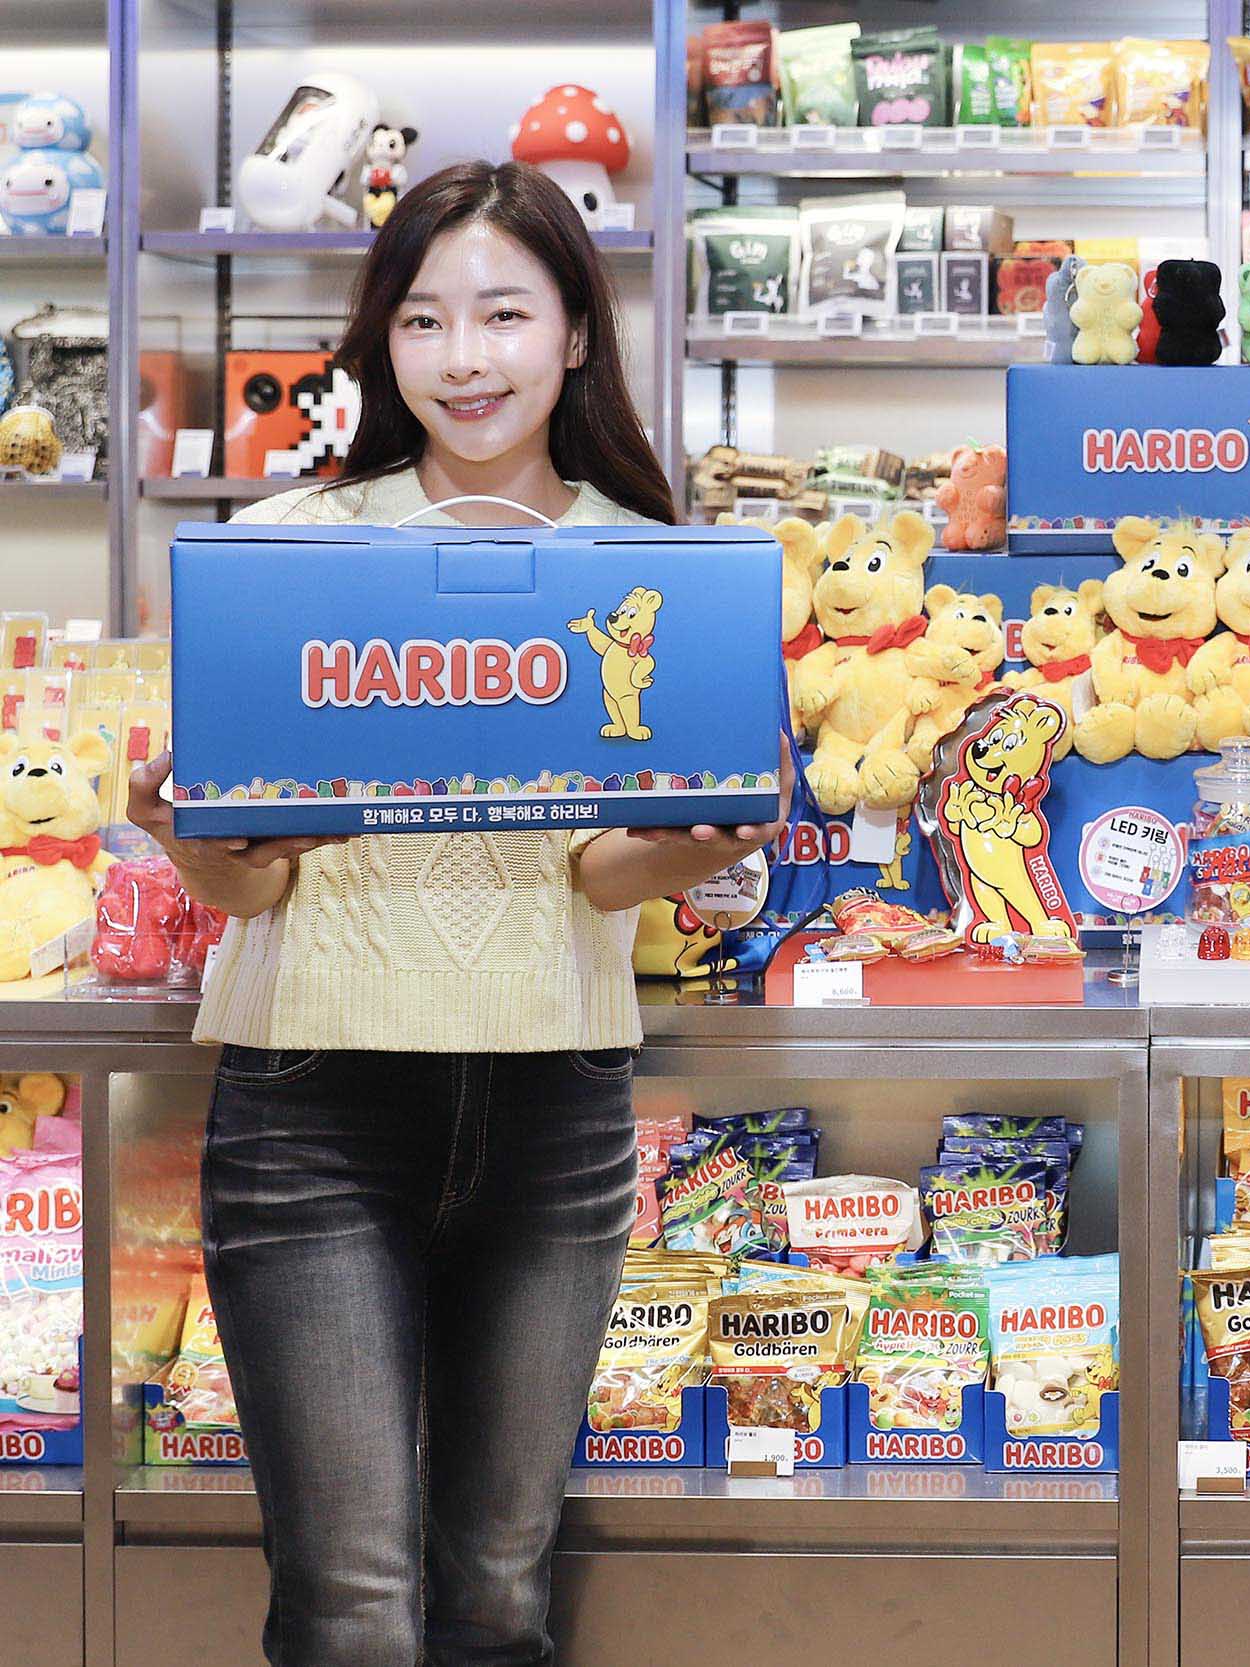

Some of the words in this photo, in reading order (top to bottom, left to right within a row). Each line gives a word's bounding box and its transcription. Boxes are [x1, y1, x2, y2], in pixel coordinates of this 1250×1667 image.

[1084, 430, 1247, 472] HARIBO
[303, 640, 566, 706] HARIBO
[362, 808, 424, 825] 함께해요
[429, 808, 458, 823] 모두
[463, 807, 483, 823] 다,
[487, 805, 546, 822] 행복해요
[550, 804, 599, 820] 하리보!
[1110, 818, 1138, 836] LED
[1141, 826, 1169, 845] 키링
[1029, 855, 1062, 910] HARIBO
[4, 1188, 82, 1232] RIB
[804, 1194, 899, 1220] HARIBO
[934, 1182, 1034, 1215] HARIBO
[609, 1303, 692, 1330] ARIBO
[722, 1309, 830, 1337] HARIBO
[870, 1310, 979, 1338] HARIBO
[1000, 1304, 1105, 1334] HARIBO
[734, 1341, 817, 1357] Goldbären
[945, 1341, 979, 1356] ZOURR
[586, 1437, 683, 1461] HARIBO
[764, 1453, 789, 1463] 1,900
[868, 1434, 965, 1458] HARIBO
[1004, 1443, 1102, 1467] HARIBO
[1216, 1466, 1242, 1475] 3,500
